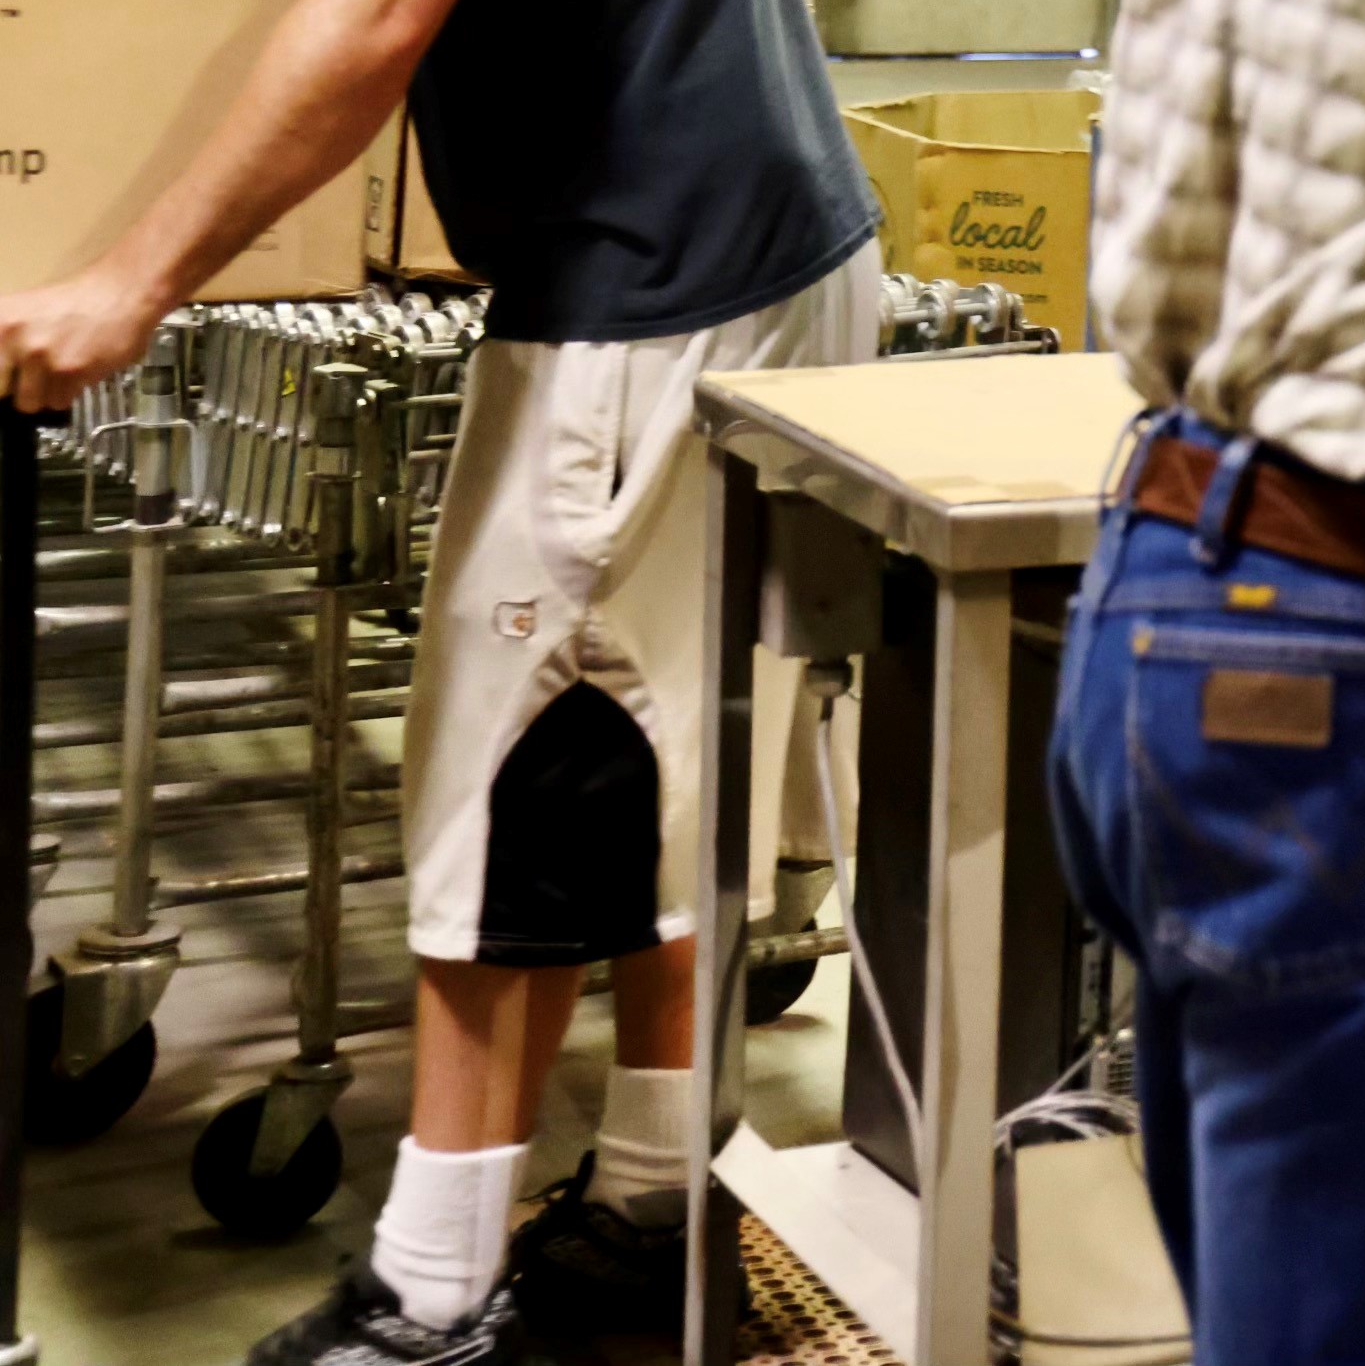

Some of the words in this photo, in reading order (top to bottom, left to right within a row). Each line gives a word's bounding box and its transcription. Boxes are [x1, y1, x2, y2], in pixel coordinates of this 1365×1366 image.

[973, 190, 1024, 207] FRESH
[950, 201, 1047, 252] local
[956, 256, 974, 268] IN
[977, 257, 1043, 275] SEASON
